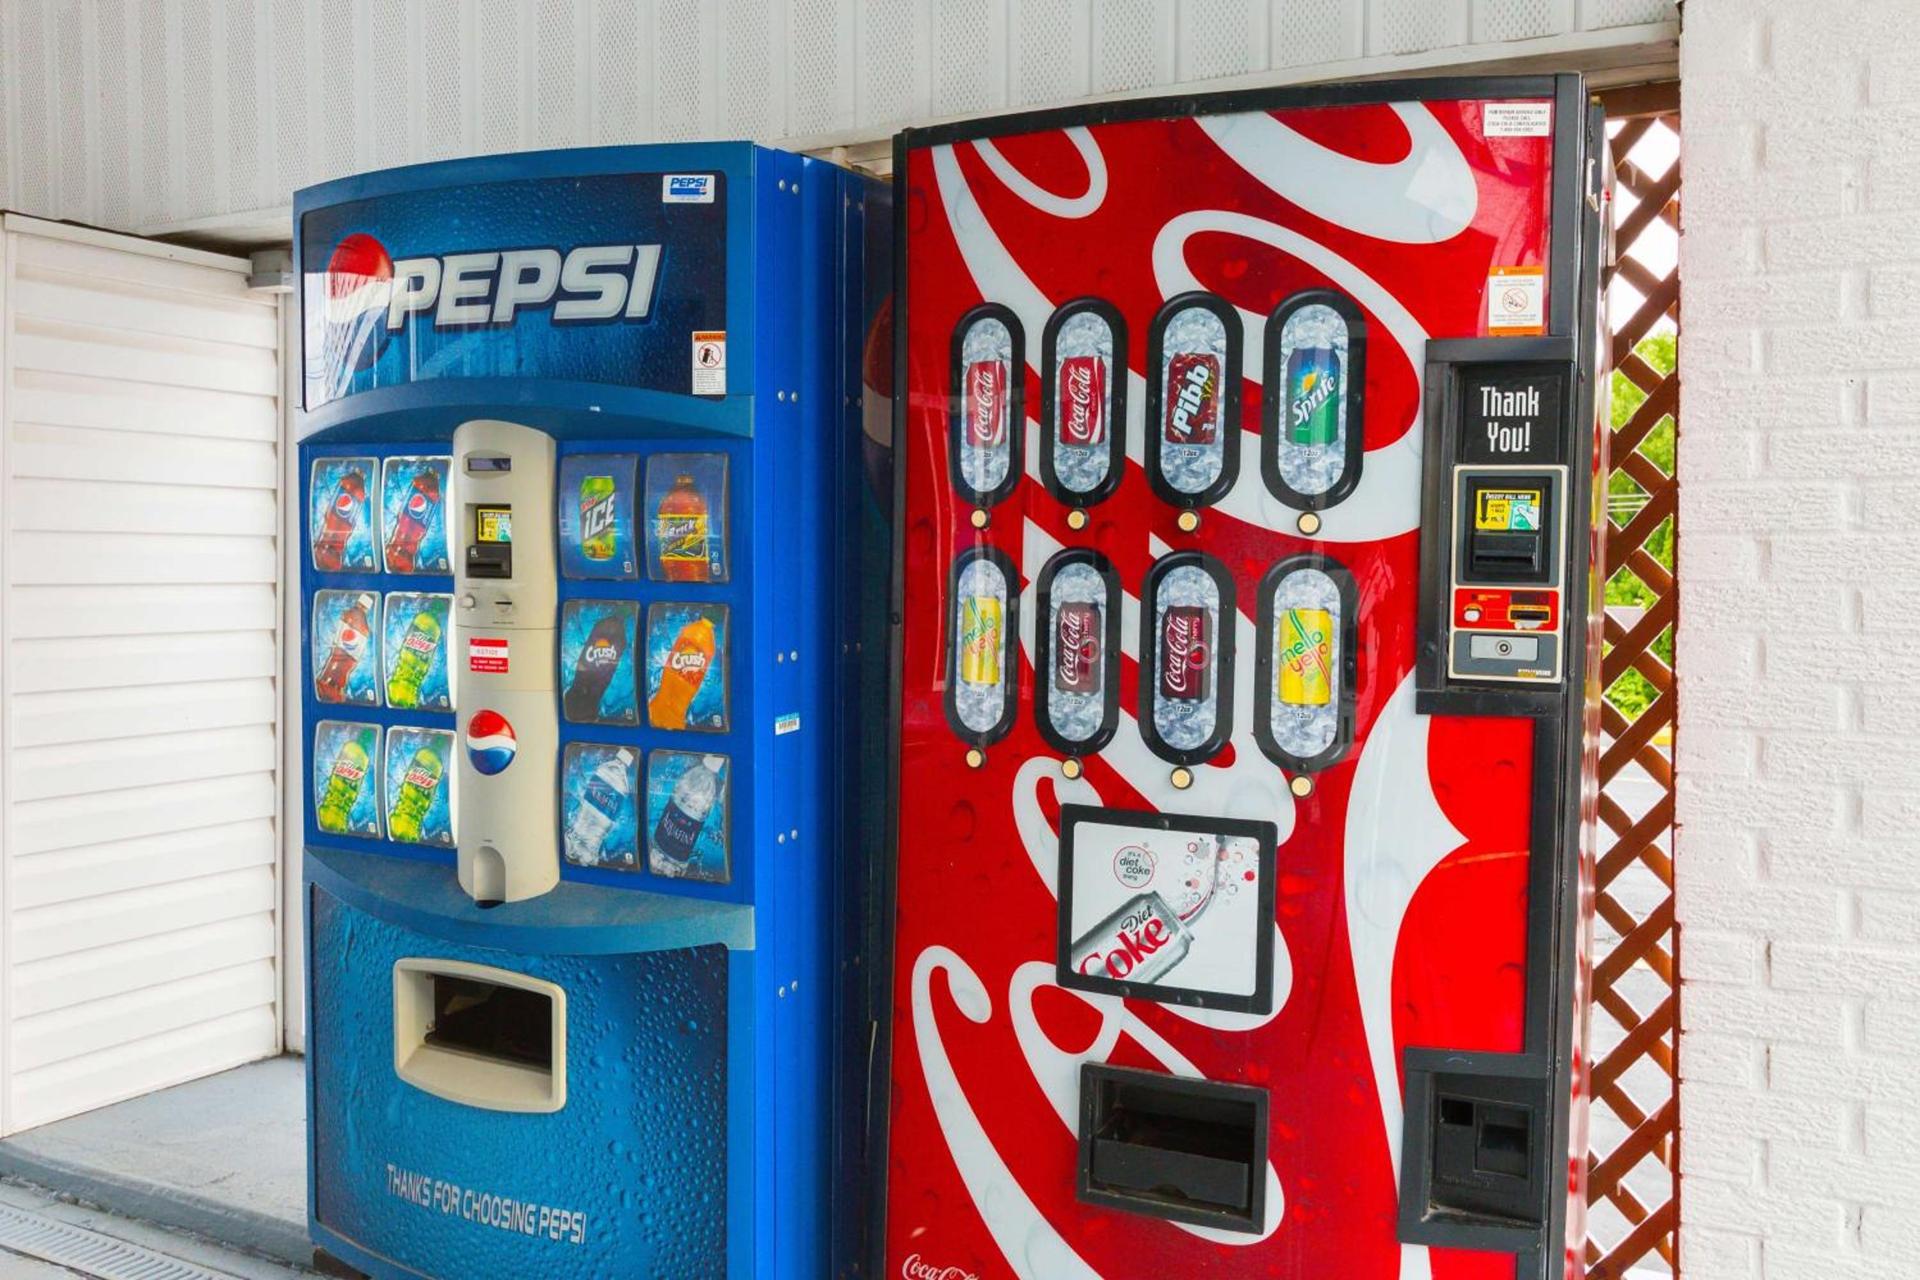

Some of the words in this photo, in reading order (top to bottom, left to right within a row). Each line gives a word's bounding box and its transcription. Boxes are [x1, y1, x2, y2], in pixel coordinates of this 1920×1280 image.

[670, 177, 708, 187] PEPSI
[387, 244, 662, 329] PEPSI
[974, 368, 993, 441] Coca-Cola
[1068, 363, 1091, 440] Coca-Cola
[1172, 364, 1210, 435] Pibb
[1292, 370, 1336, 426] Sprite
[1480, 386, 1540, 416] Thank
[1487, 421, 1531, 452] You!
[585, 493, 615, 539] ICE
[585, 644, 617, 662] Crush
[672, 651, 706, 670] Crush
[1060, 609, 1080, 685] Coca-Cola
[1165, 613, 1188, 692] Coca-Cola
[1119, 857, 1139, 867] diet
[1126, 865, 1150, 875] coke
[1120, 905, 1154, 933] Diet
[387, 1163, 432, 1208] THANKS
[432, 1180, 462, 1217] FOR
[463, 1189, 537, 1236] CHOOSING
[538, 1205, 587, 1245] PEPSI
